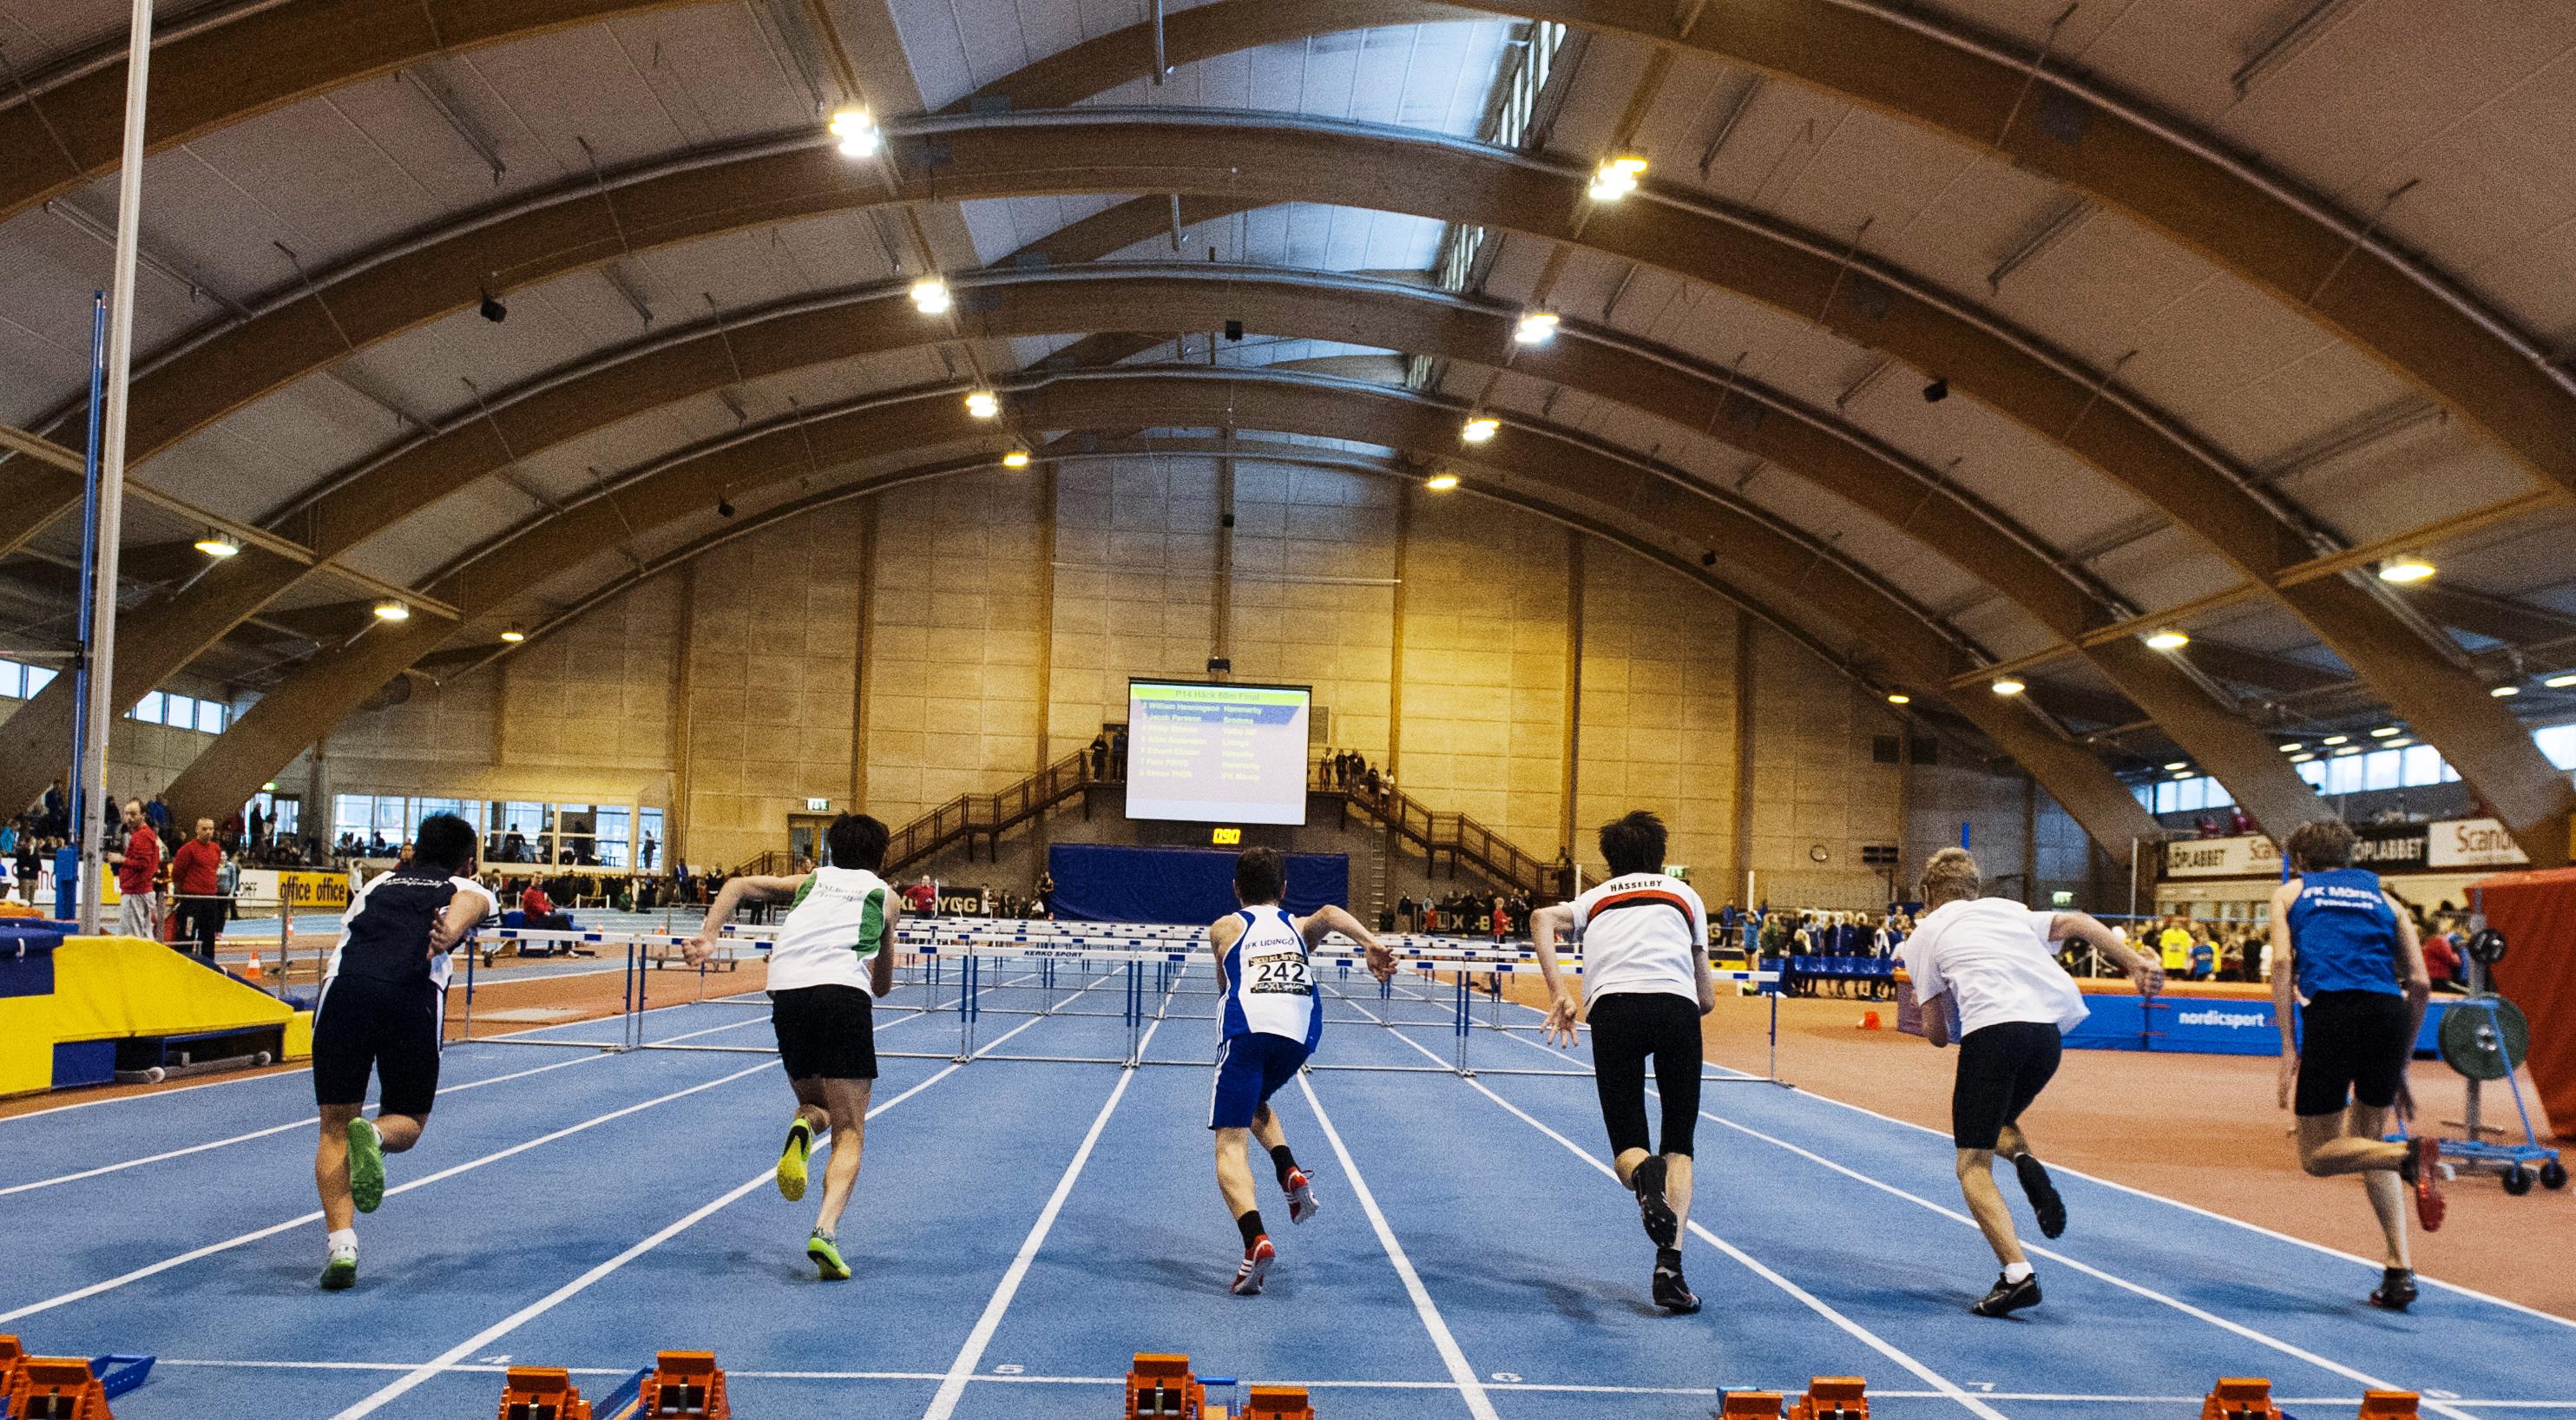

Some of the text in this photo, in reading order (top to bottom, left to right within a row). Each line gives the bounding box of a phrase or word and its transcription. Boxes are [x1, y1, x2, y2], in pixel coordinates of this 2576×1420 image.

[280, 876, 311, 900] office
[317, 876, 345, 901] office
[1610, 880, 1662, 891] HÄSSELBY
[1260, 937, 1295, 947] LIDINGÖ
[1258, 962, 1305, 983] 242
[993, 1364, 1024, 1373] 5
[1491, 1372, 1522, 1382] 6
[1967, 1382, 1995, 1391] 7
